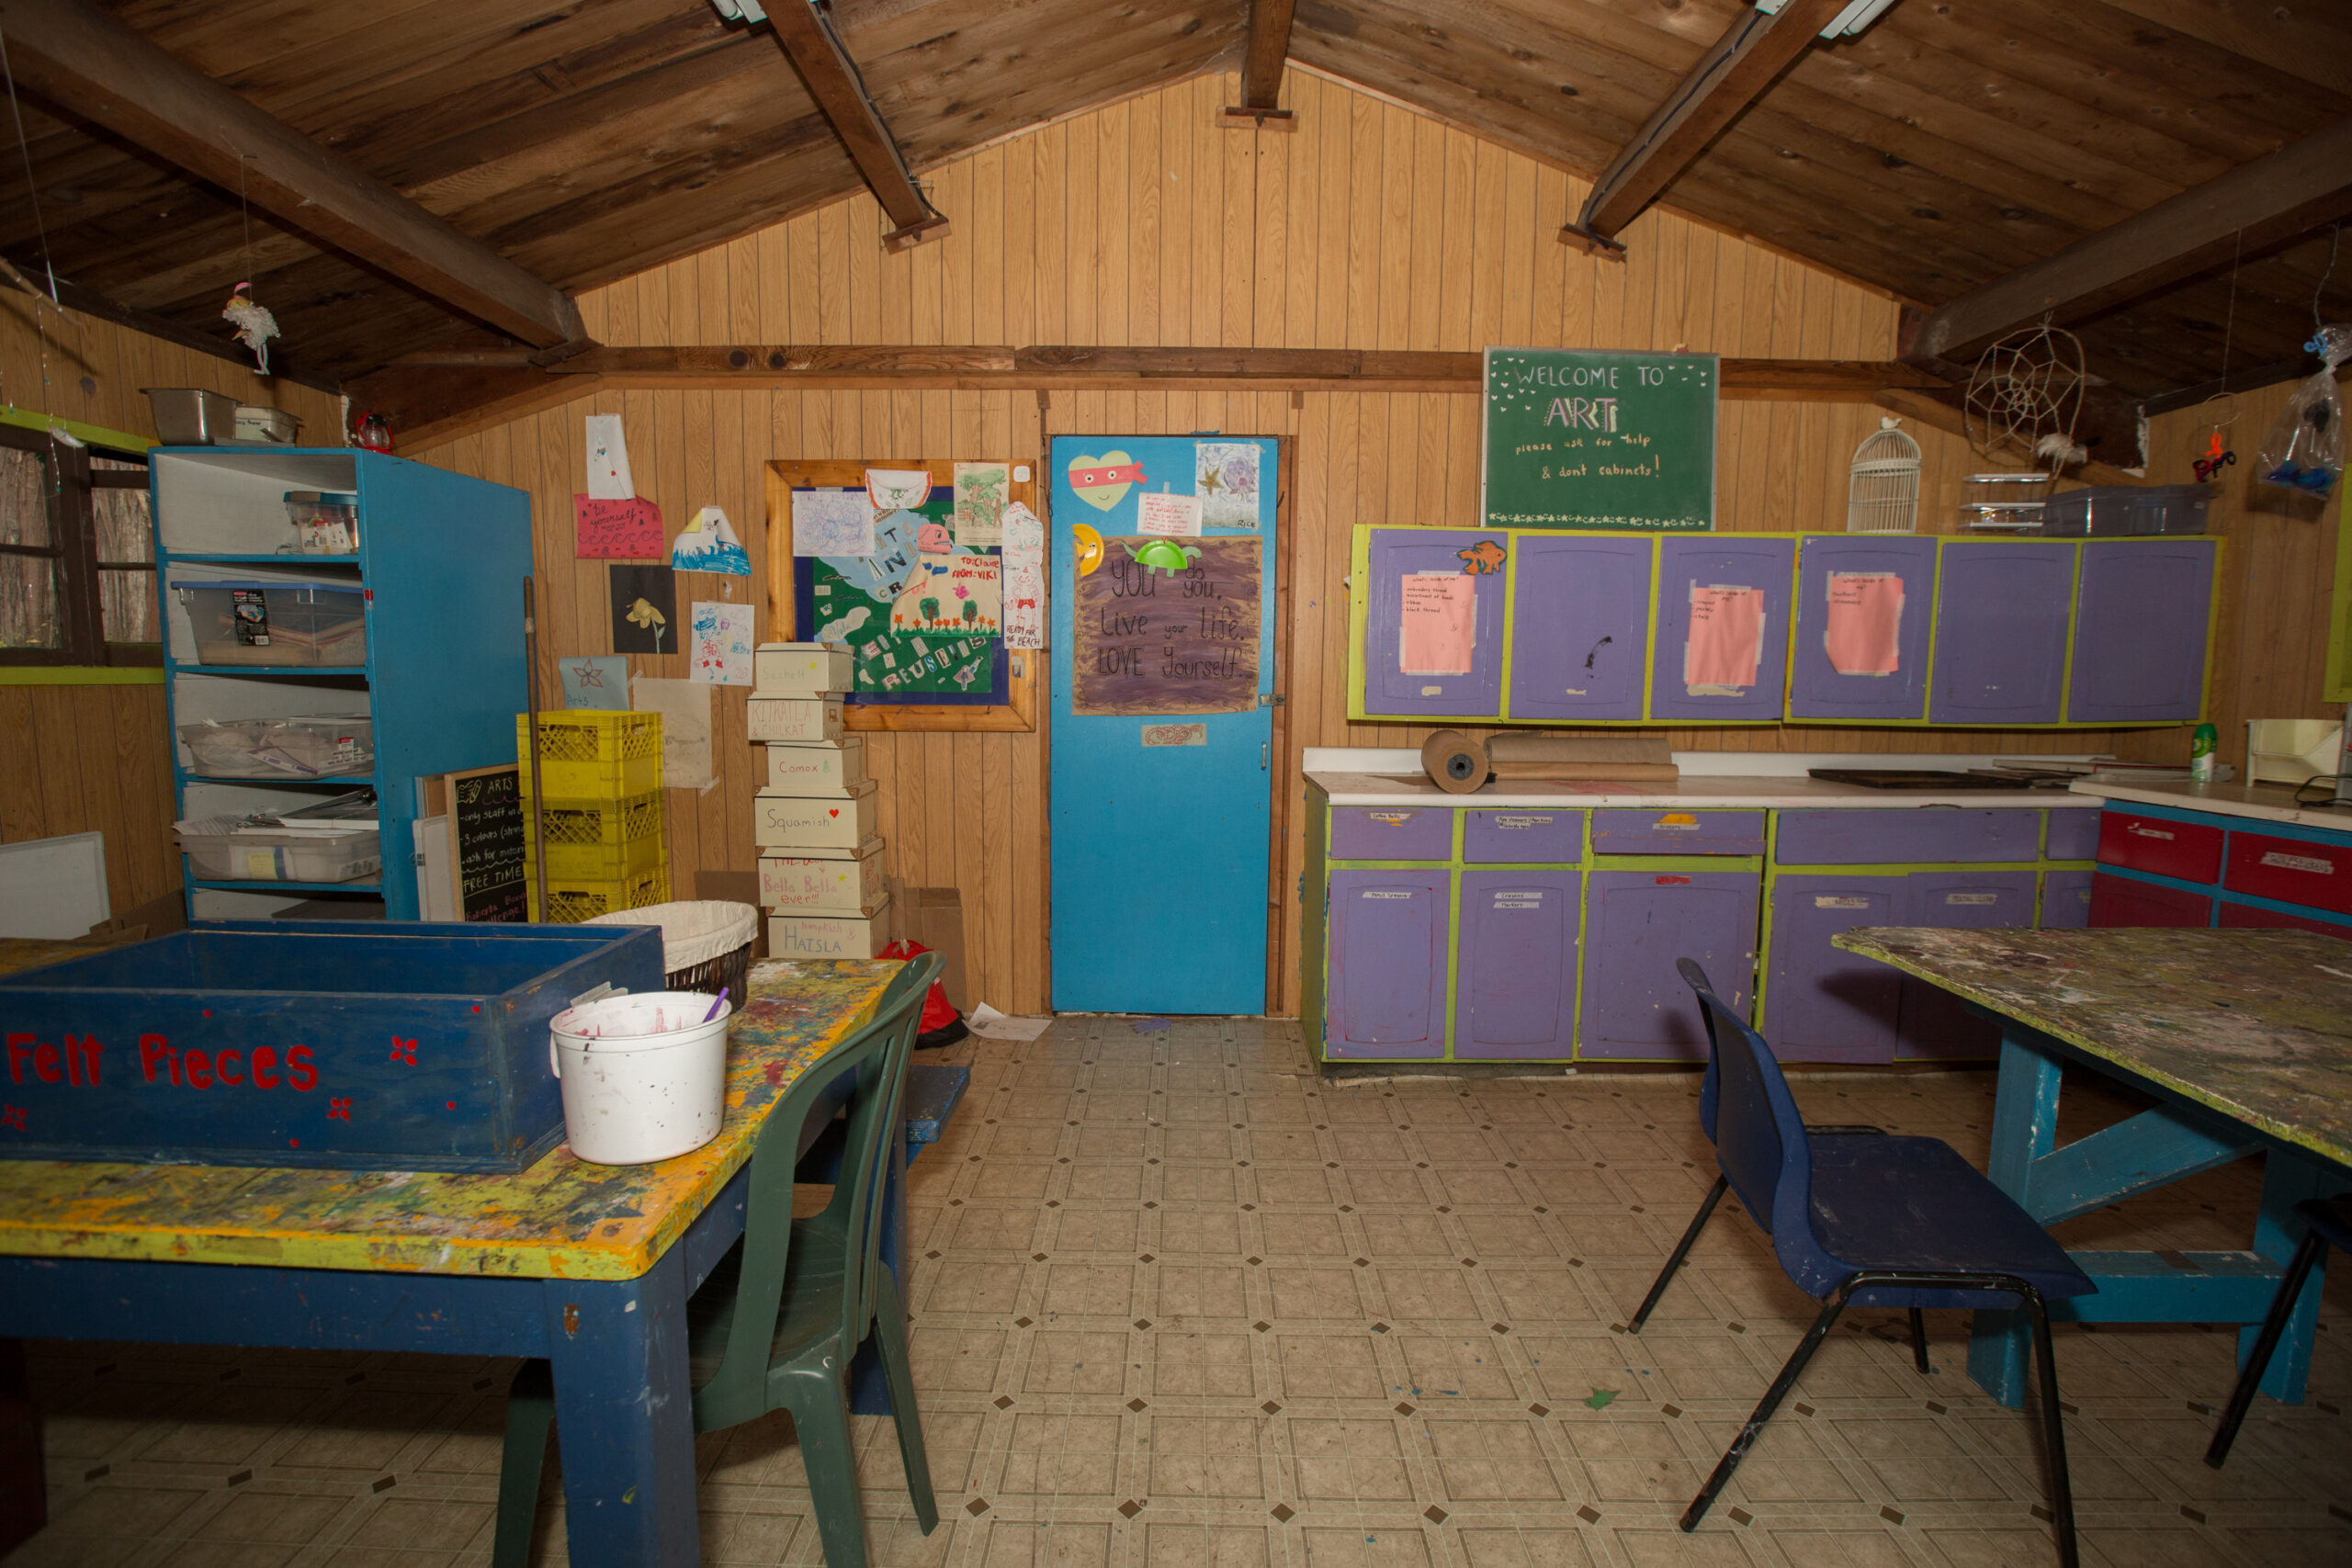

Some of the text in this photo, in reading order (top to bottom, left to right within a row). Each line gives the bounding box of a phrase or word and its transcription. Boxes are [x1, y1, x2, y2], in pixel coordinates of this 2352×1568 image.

[1514, 366, 1664, 389] WELCOME TO
[1544, 397, 1619, 433] ART
[1516, 442, 1553, 456] please
[1564, 438, 1584, 447] ask
[1596, 437, 1612, 446] for
[1542, 466, 1551, 479] &
[589, 508, 638, 534] yourself
[1184, 555, 1204, 580] do
[1182, 581, 1222, 600] you.
[1163, 624, 1187, 639] your
[1017, 637, 1040, 647] BEACH
[1098, 646, 1145, 676] LOVE
[752, 700, 811, 722] KITKATLA
[762, 724, 806, 736] CHILKAT
[779, 761, 818, 773] Comox
[487, 776, 513, 795] ARTS
[483, 807, 505, 819] staff
[508, 807, 515, 816] in
[767, 808, 830, 832] Squamish
[472, 829, 498, 844] colours
[484, 849, 496, 861] for
[463, 874, 489, 893] FREE
[763, 874, 837, 893] Bella Bella
[785, 925, 842, 953] HAISLA
[7, 1032, 318, 1091] Felt Pieces
